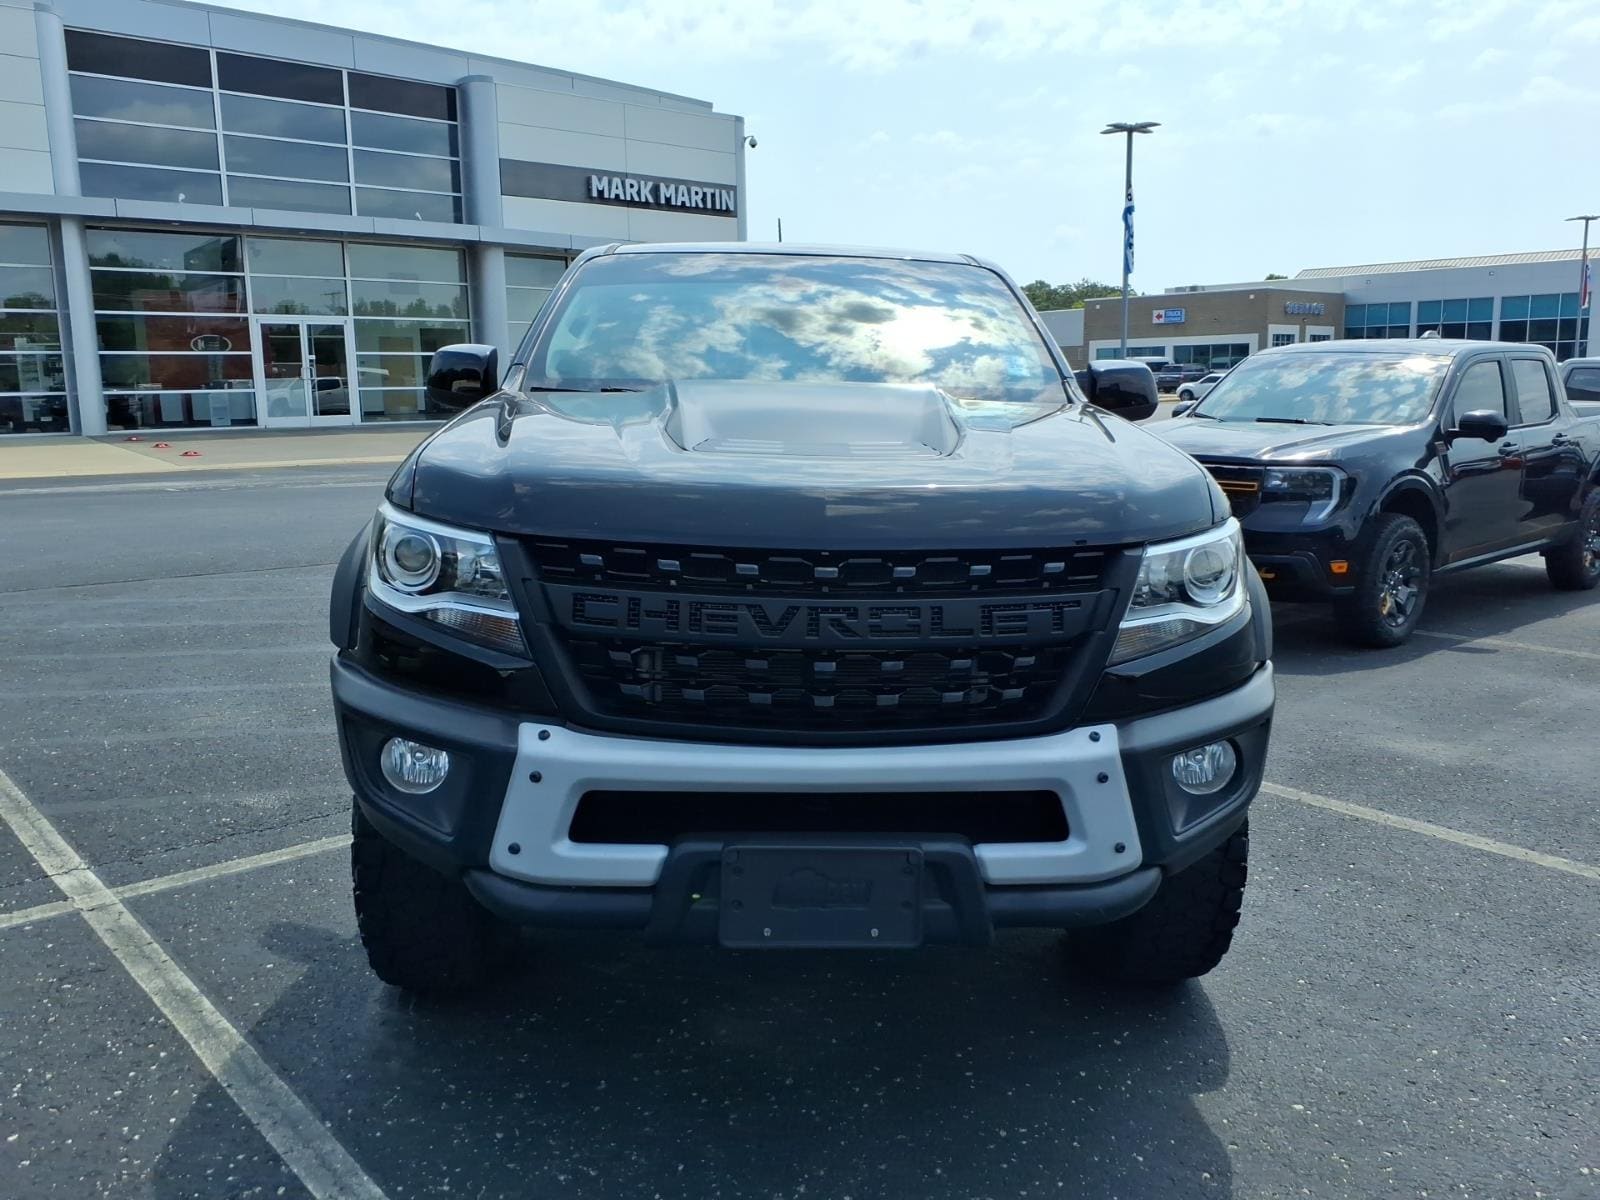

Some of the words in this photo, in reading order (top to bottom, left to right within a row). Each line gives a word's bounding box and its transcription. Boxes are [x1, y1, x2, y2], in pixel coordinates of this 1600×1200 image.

[590, 174, 655, 203] MARK
[658, 182, 735, 211] MARTIN
[571, 592, 1082, 639] CHEVROLET
